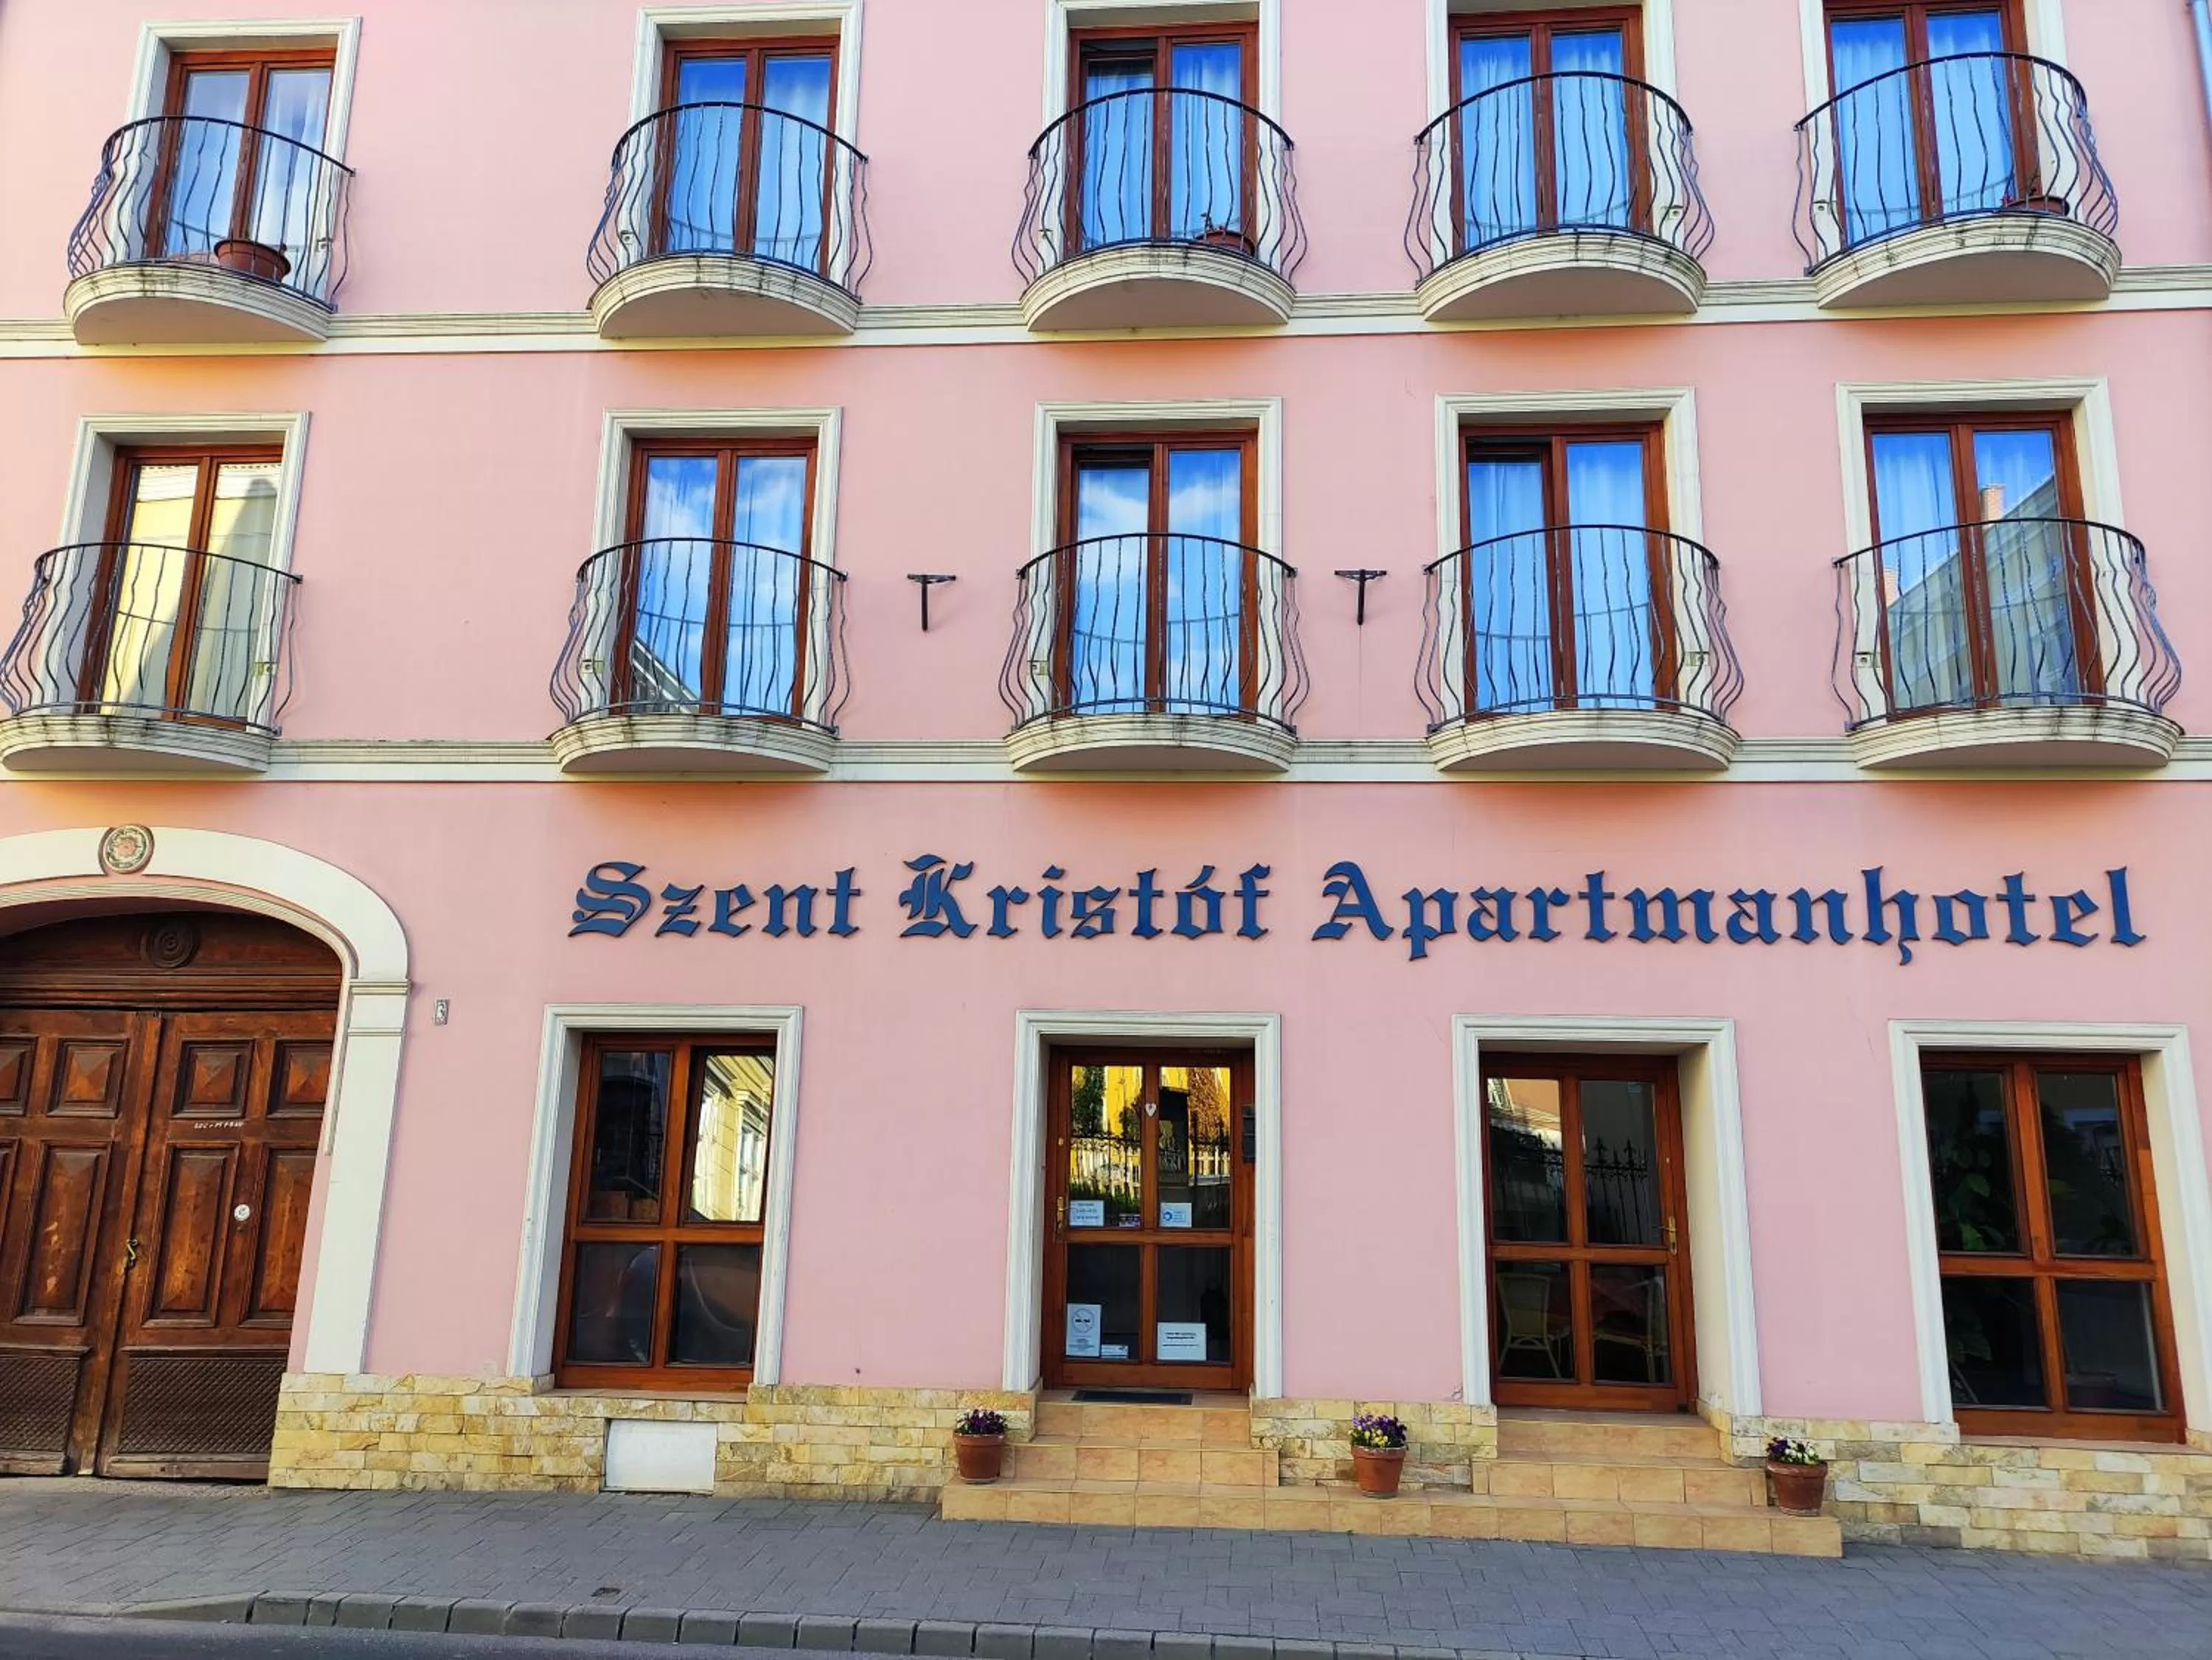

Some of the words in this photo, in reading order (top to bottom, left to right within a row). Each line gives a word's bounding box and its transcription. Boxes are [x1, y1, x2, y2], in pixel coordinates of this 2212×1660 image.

[568, 861, 862, 938] Szent
[899, 854, 1272, 941] Kristóf
[1312, 861, 2147, 966] Apartmanhotel
